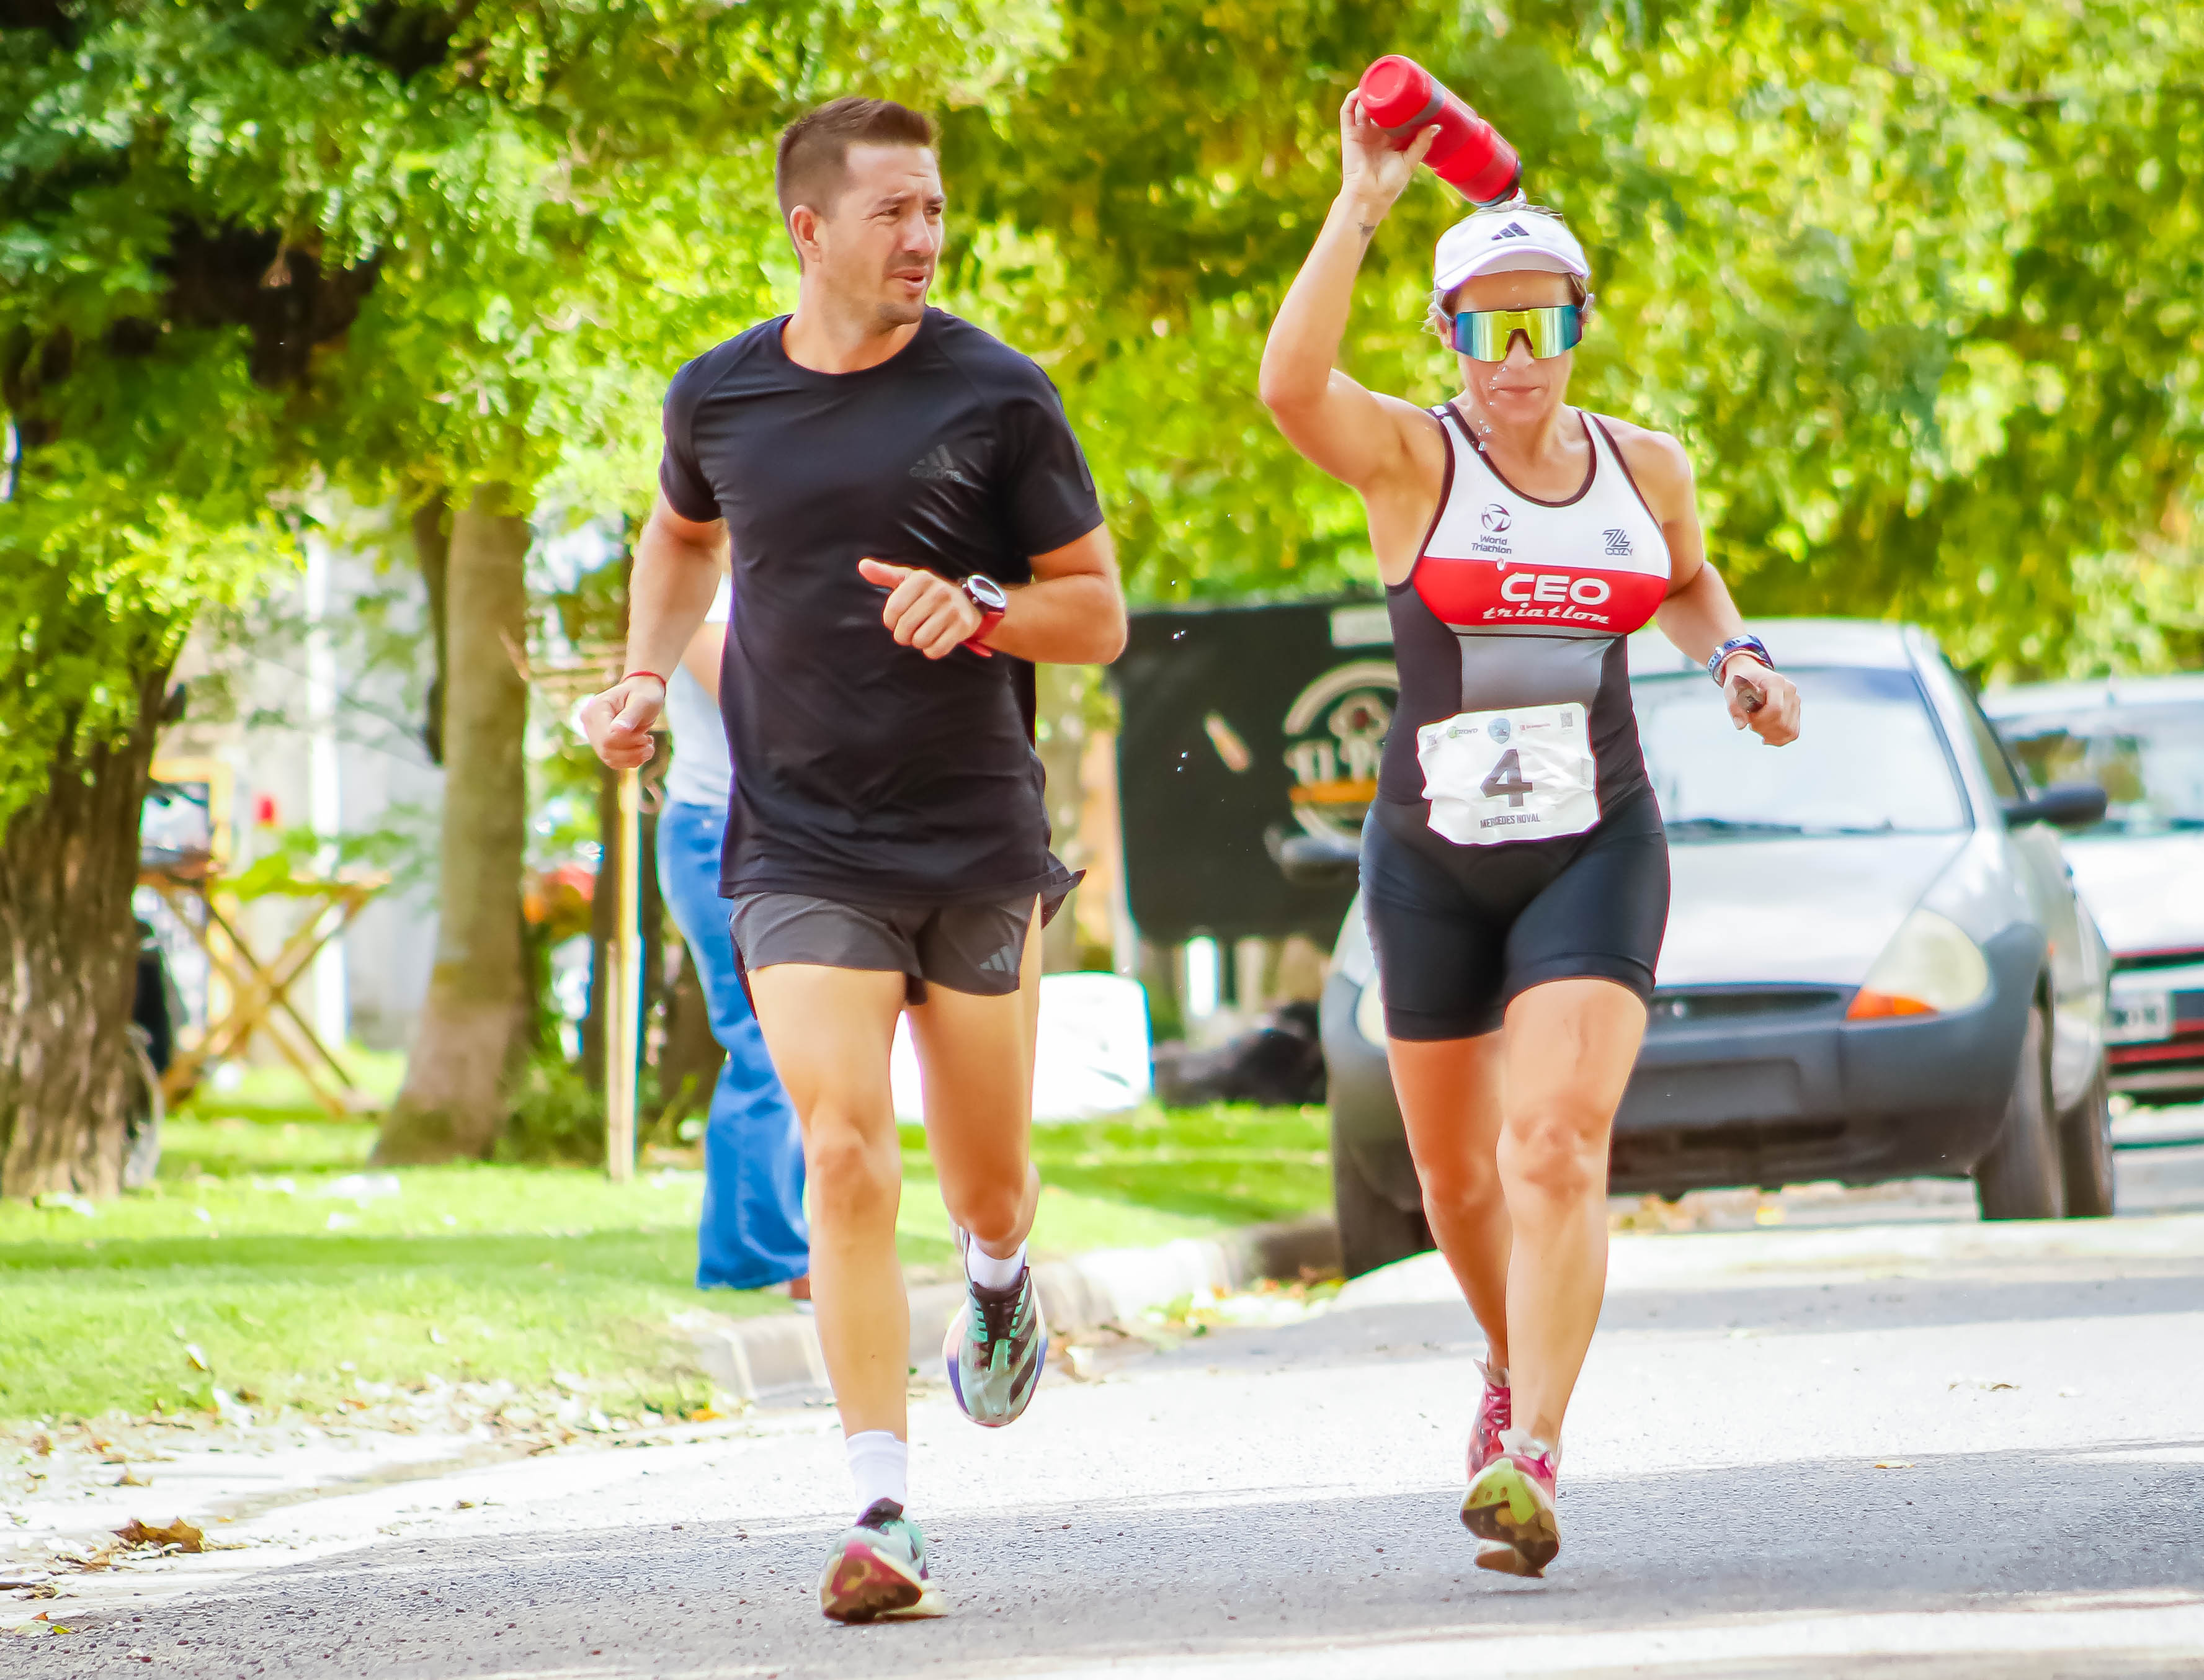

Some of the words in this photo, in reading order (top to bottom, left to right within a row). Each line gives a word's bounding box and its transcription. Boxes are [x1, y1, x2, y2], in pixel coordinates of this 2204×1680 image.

[1480, 535, 1508, 545] World
[1471, 542, 1512, 554] Triathlon
[1605, 547, 1633, 556] COZY
[1501, 572, 1610, 605] CEO
[1482, 602, 1610, 624] triatlon
[1480, 749, 1533, 808] 4
[1480, 815, 1515, 829] MERCEDES
